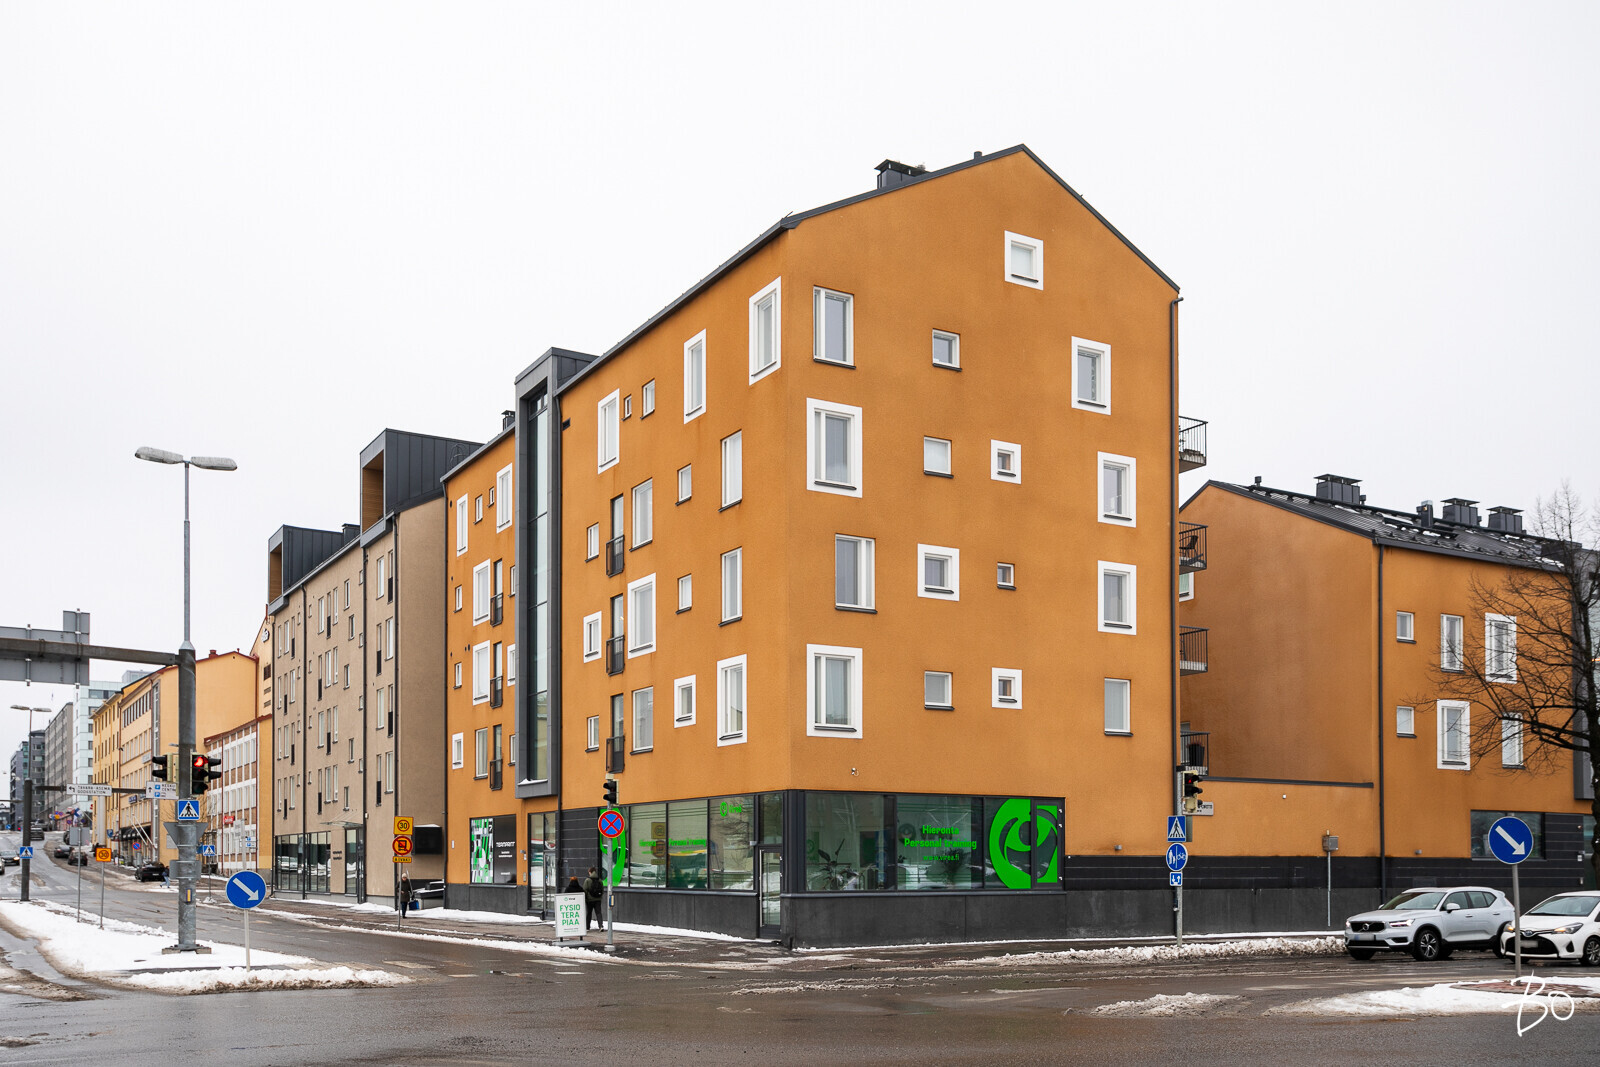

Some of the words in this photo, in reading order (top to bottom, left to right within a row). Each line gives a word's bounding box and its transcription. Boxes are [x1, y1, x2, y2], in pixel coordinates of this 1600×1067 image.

[922, 825, 960, 835] Hieronta
[904, 837, 942, 848] Personal
[944, 838, 977, 850] training
